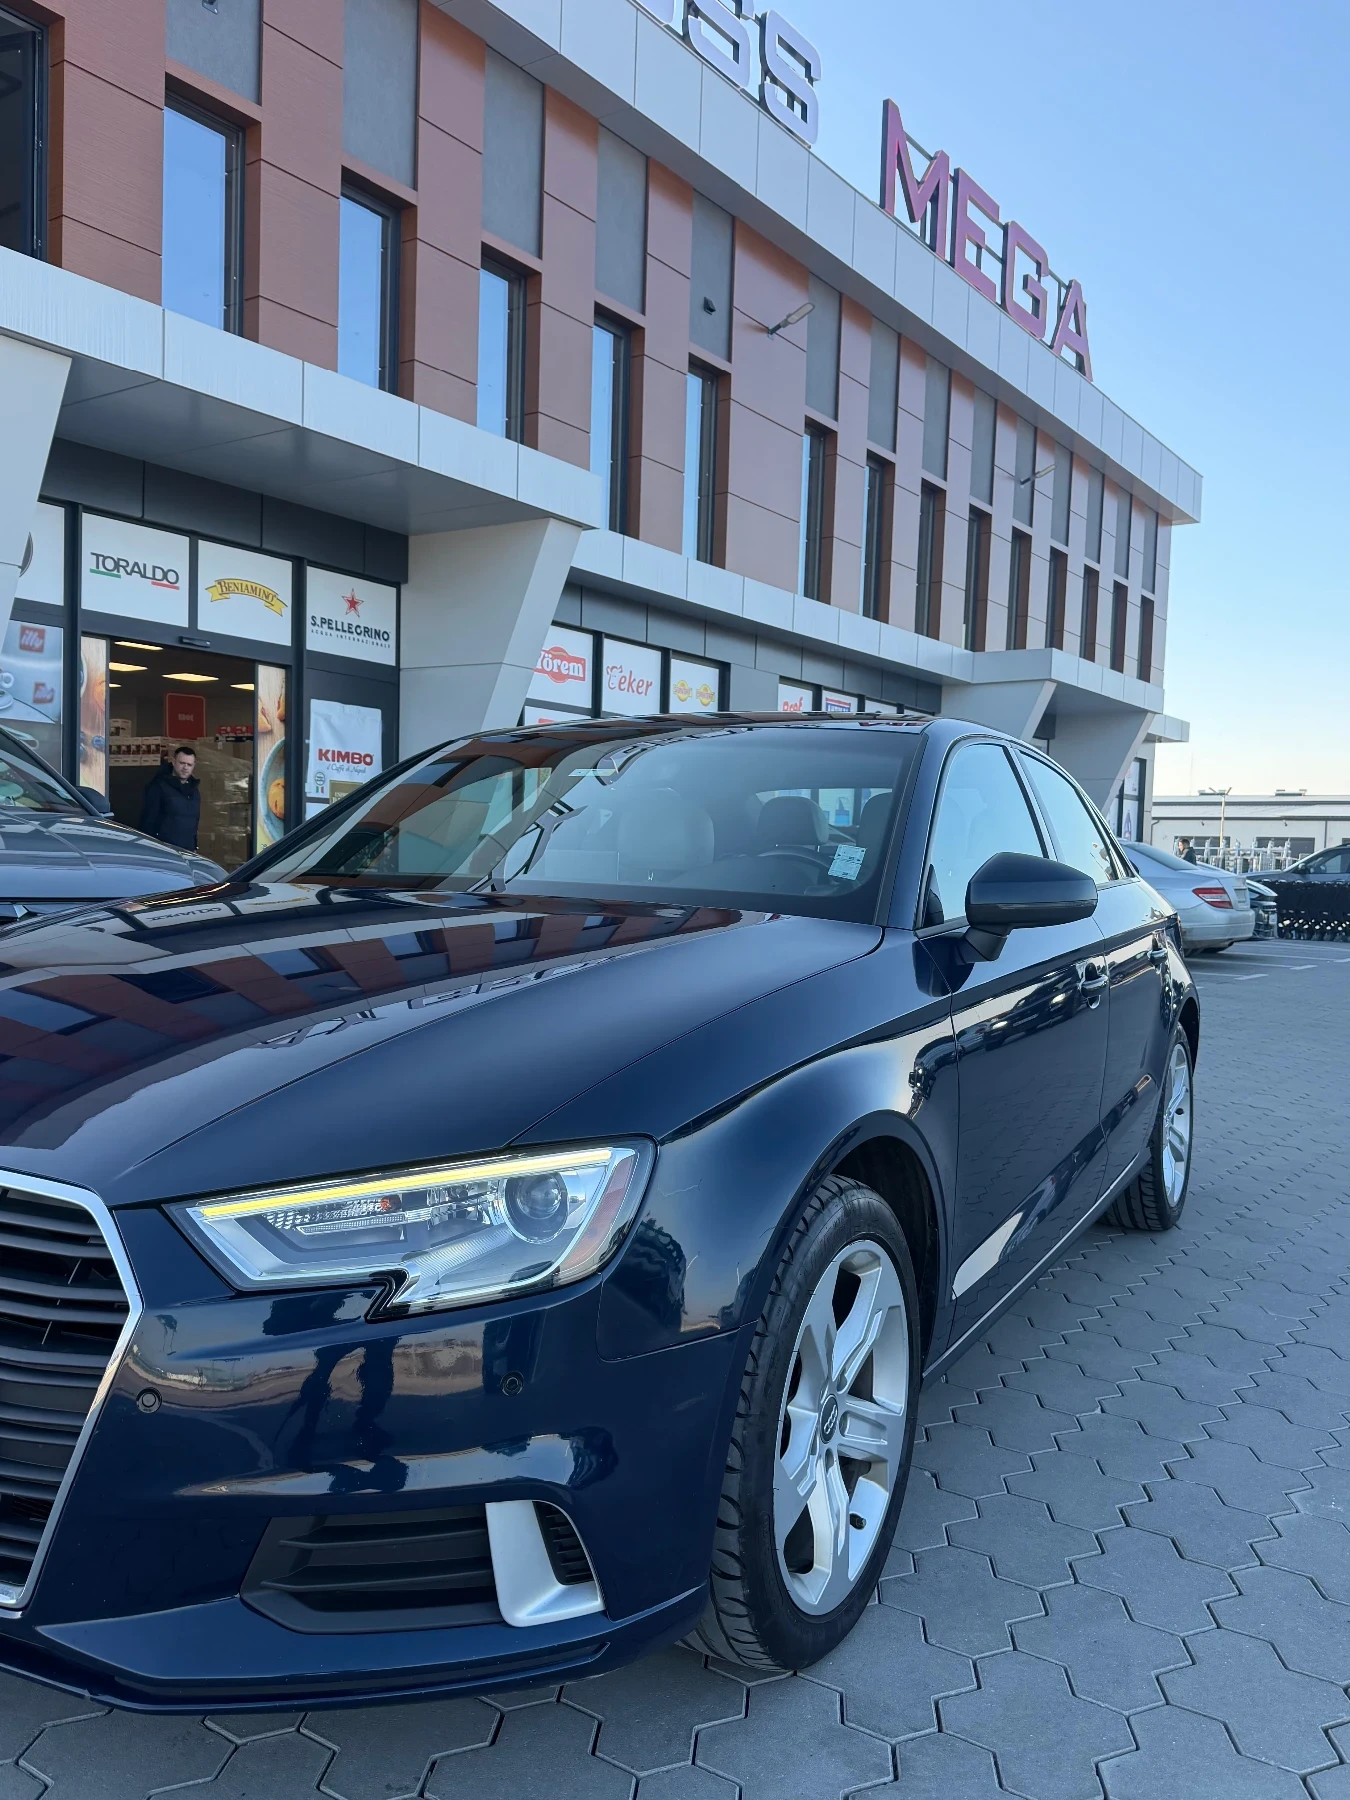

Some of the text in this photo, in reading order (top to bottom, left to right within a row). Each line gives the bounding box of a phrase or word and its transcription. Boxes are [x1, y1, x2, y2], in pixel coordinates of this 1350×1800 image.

[628, 0, 1093, 382] SS MEGA
[90, 552, 180, 585] TORALDO
[217, 580, 277, 603] BENIAMINO
[21, 629, 43, 648] illy
[310, 615, 390, 642] S.PELLEGRINO
[311, 628, 333, 637] ACQUA
[318, 748, 374, 767] KIMBO
